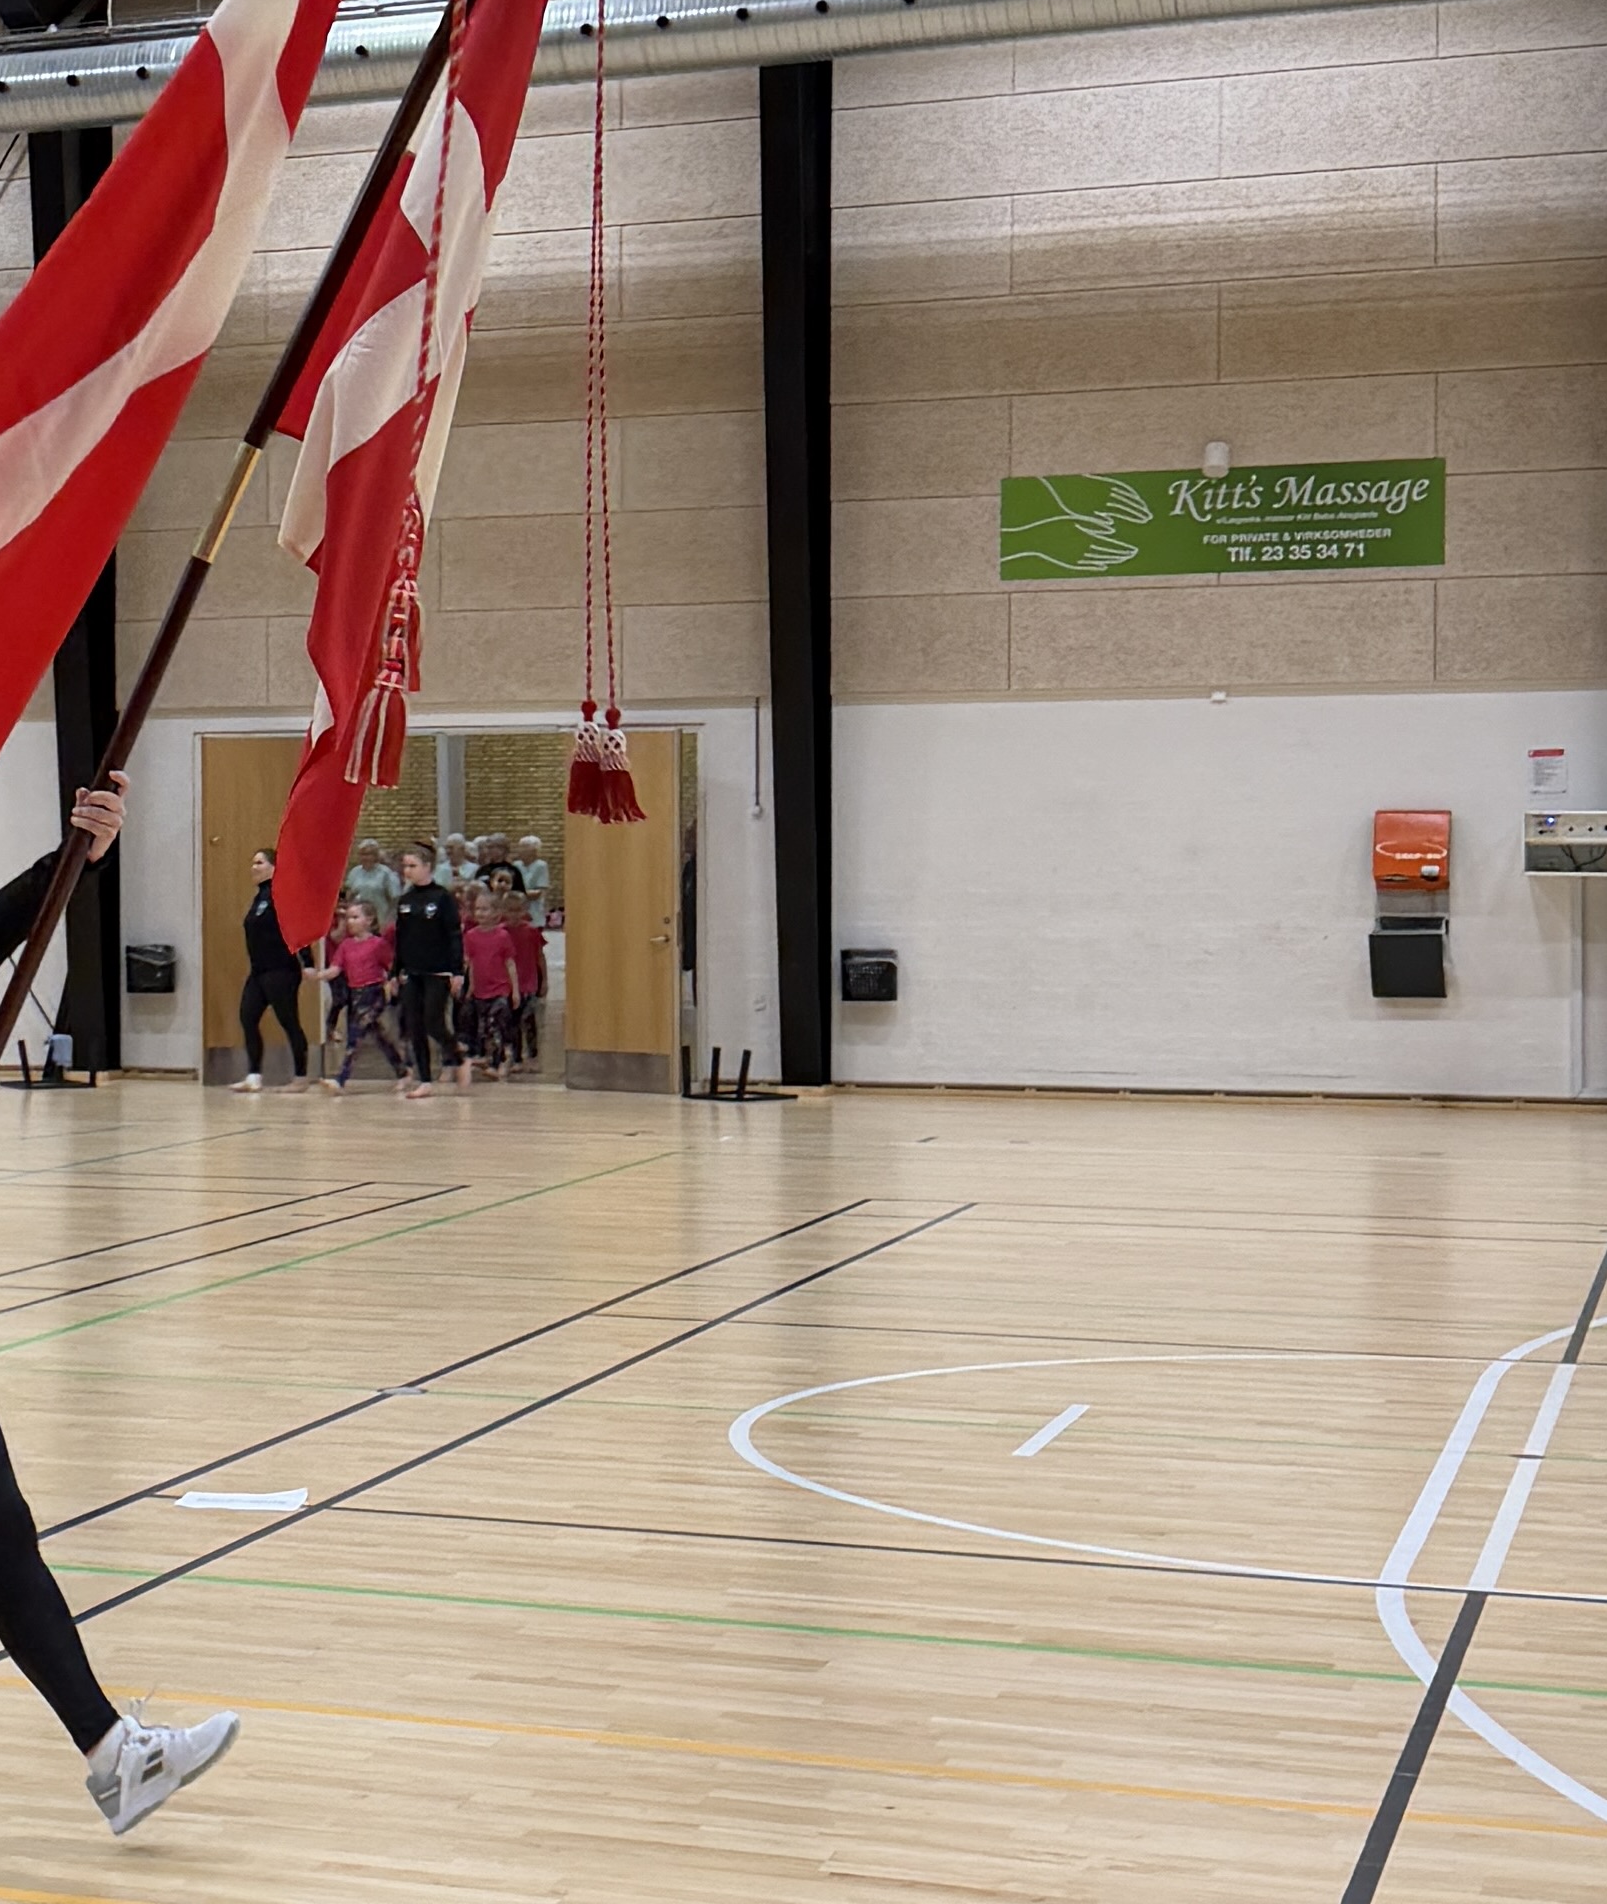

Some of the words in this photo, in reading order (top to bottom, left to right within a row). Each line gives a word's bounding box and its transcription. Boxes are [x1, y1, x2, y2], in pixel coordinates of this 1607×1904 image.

[1168, 474, 1264, 522] Kitt's
[1272, 475, 1430, 514] Massage
[1203, 534, 1227, 545] FOR
[1231, 531, 1280, 543] PRIVATE
[1282, 531, 1291, 542] &
[1294, 527, 1392, 541] VIRKSOMHEDER
[1226, 546, 1257, 563] Tlf.
[1261, 545, 1284, 562] 23
[1288, 544, 1312, 560] 35
[1316, 543, 1339, 559] 34
[1344, 542, 1366, 558] 71
